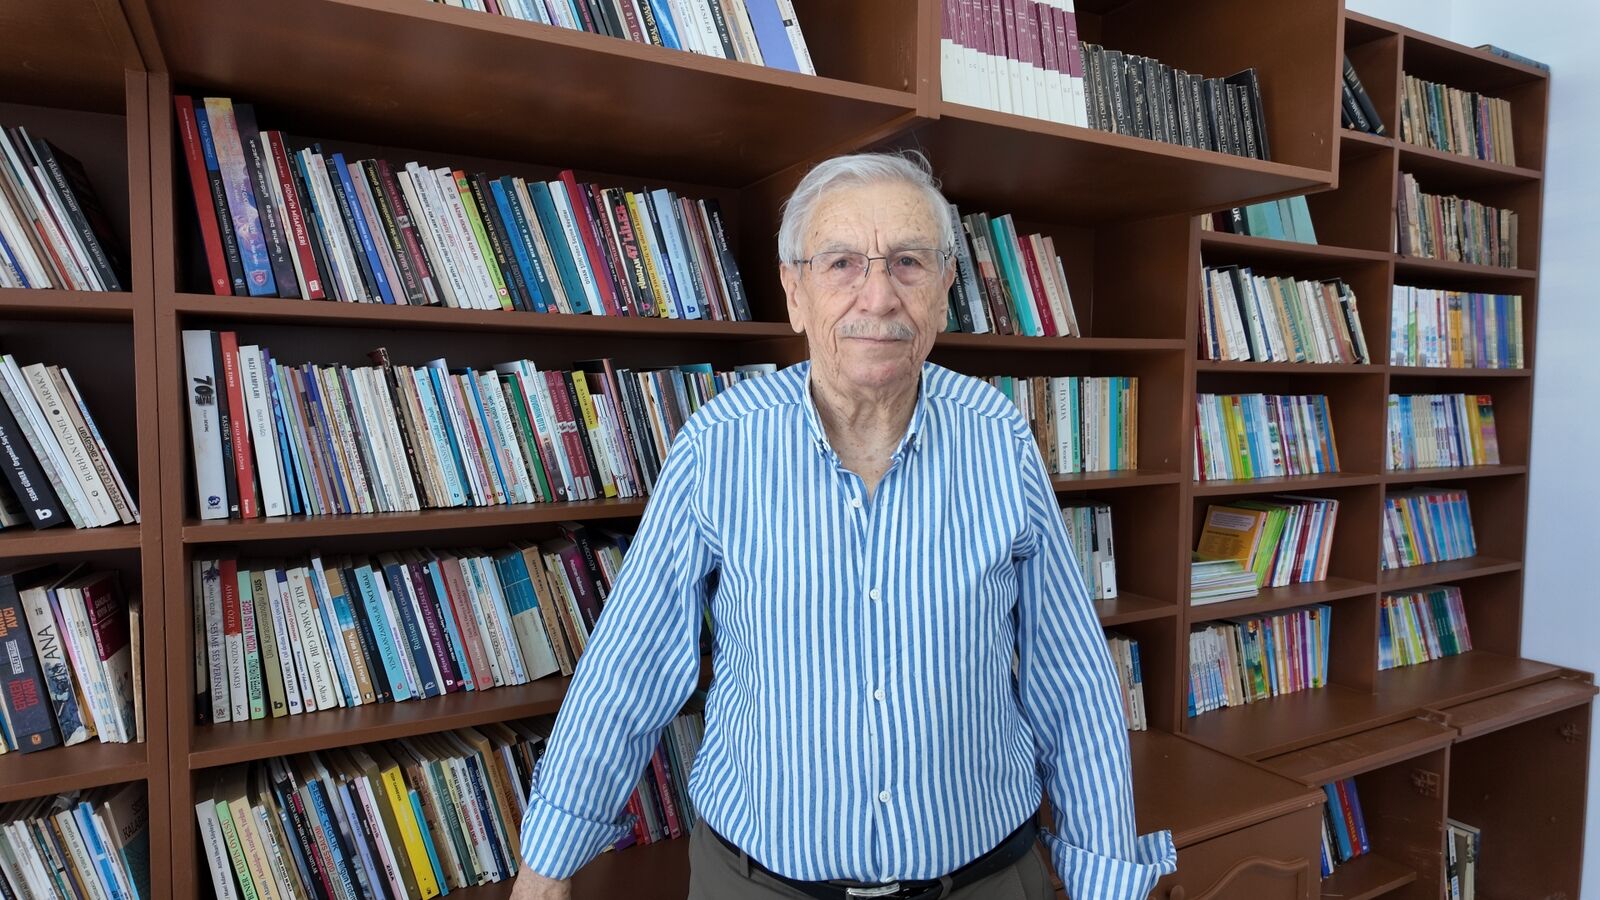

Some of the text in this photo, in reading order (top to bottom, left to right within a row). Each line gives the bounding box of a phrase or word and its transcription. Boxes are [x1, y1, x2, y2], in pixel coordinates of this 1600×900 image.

[33, 371, 93, 481] BURHAN GÜNEL BARAKA
[300, 609, 314, 638] YARASI
[38, 625, 60, 660] ANA
